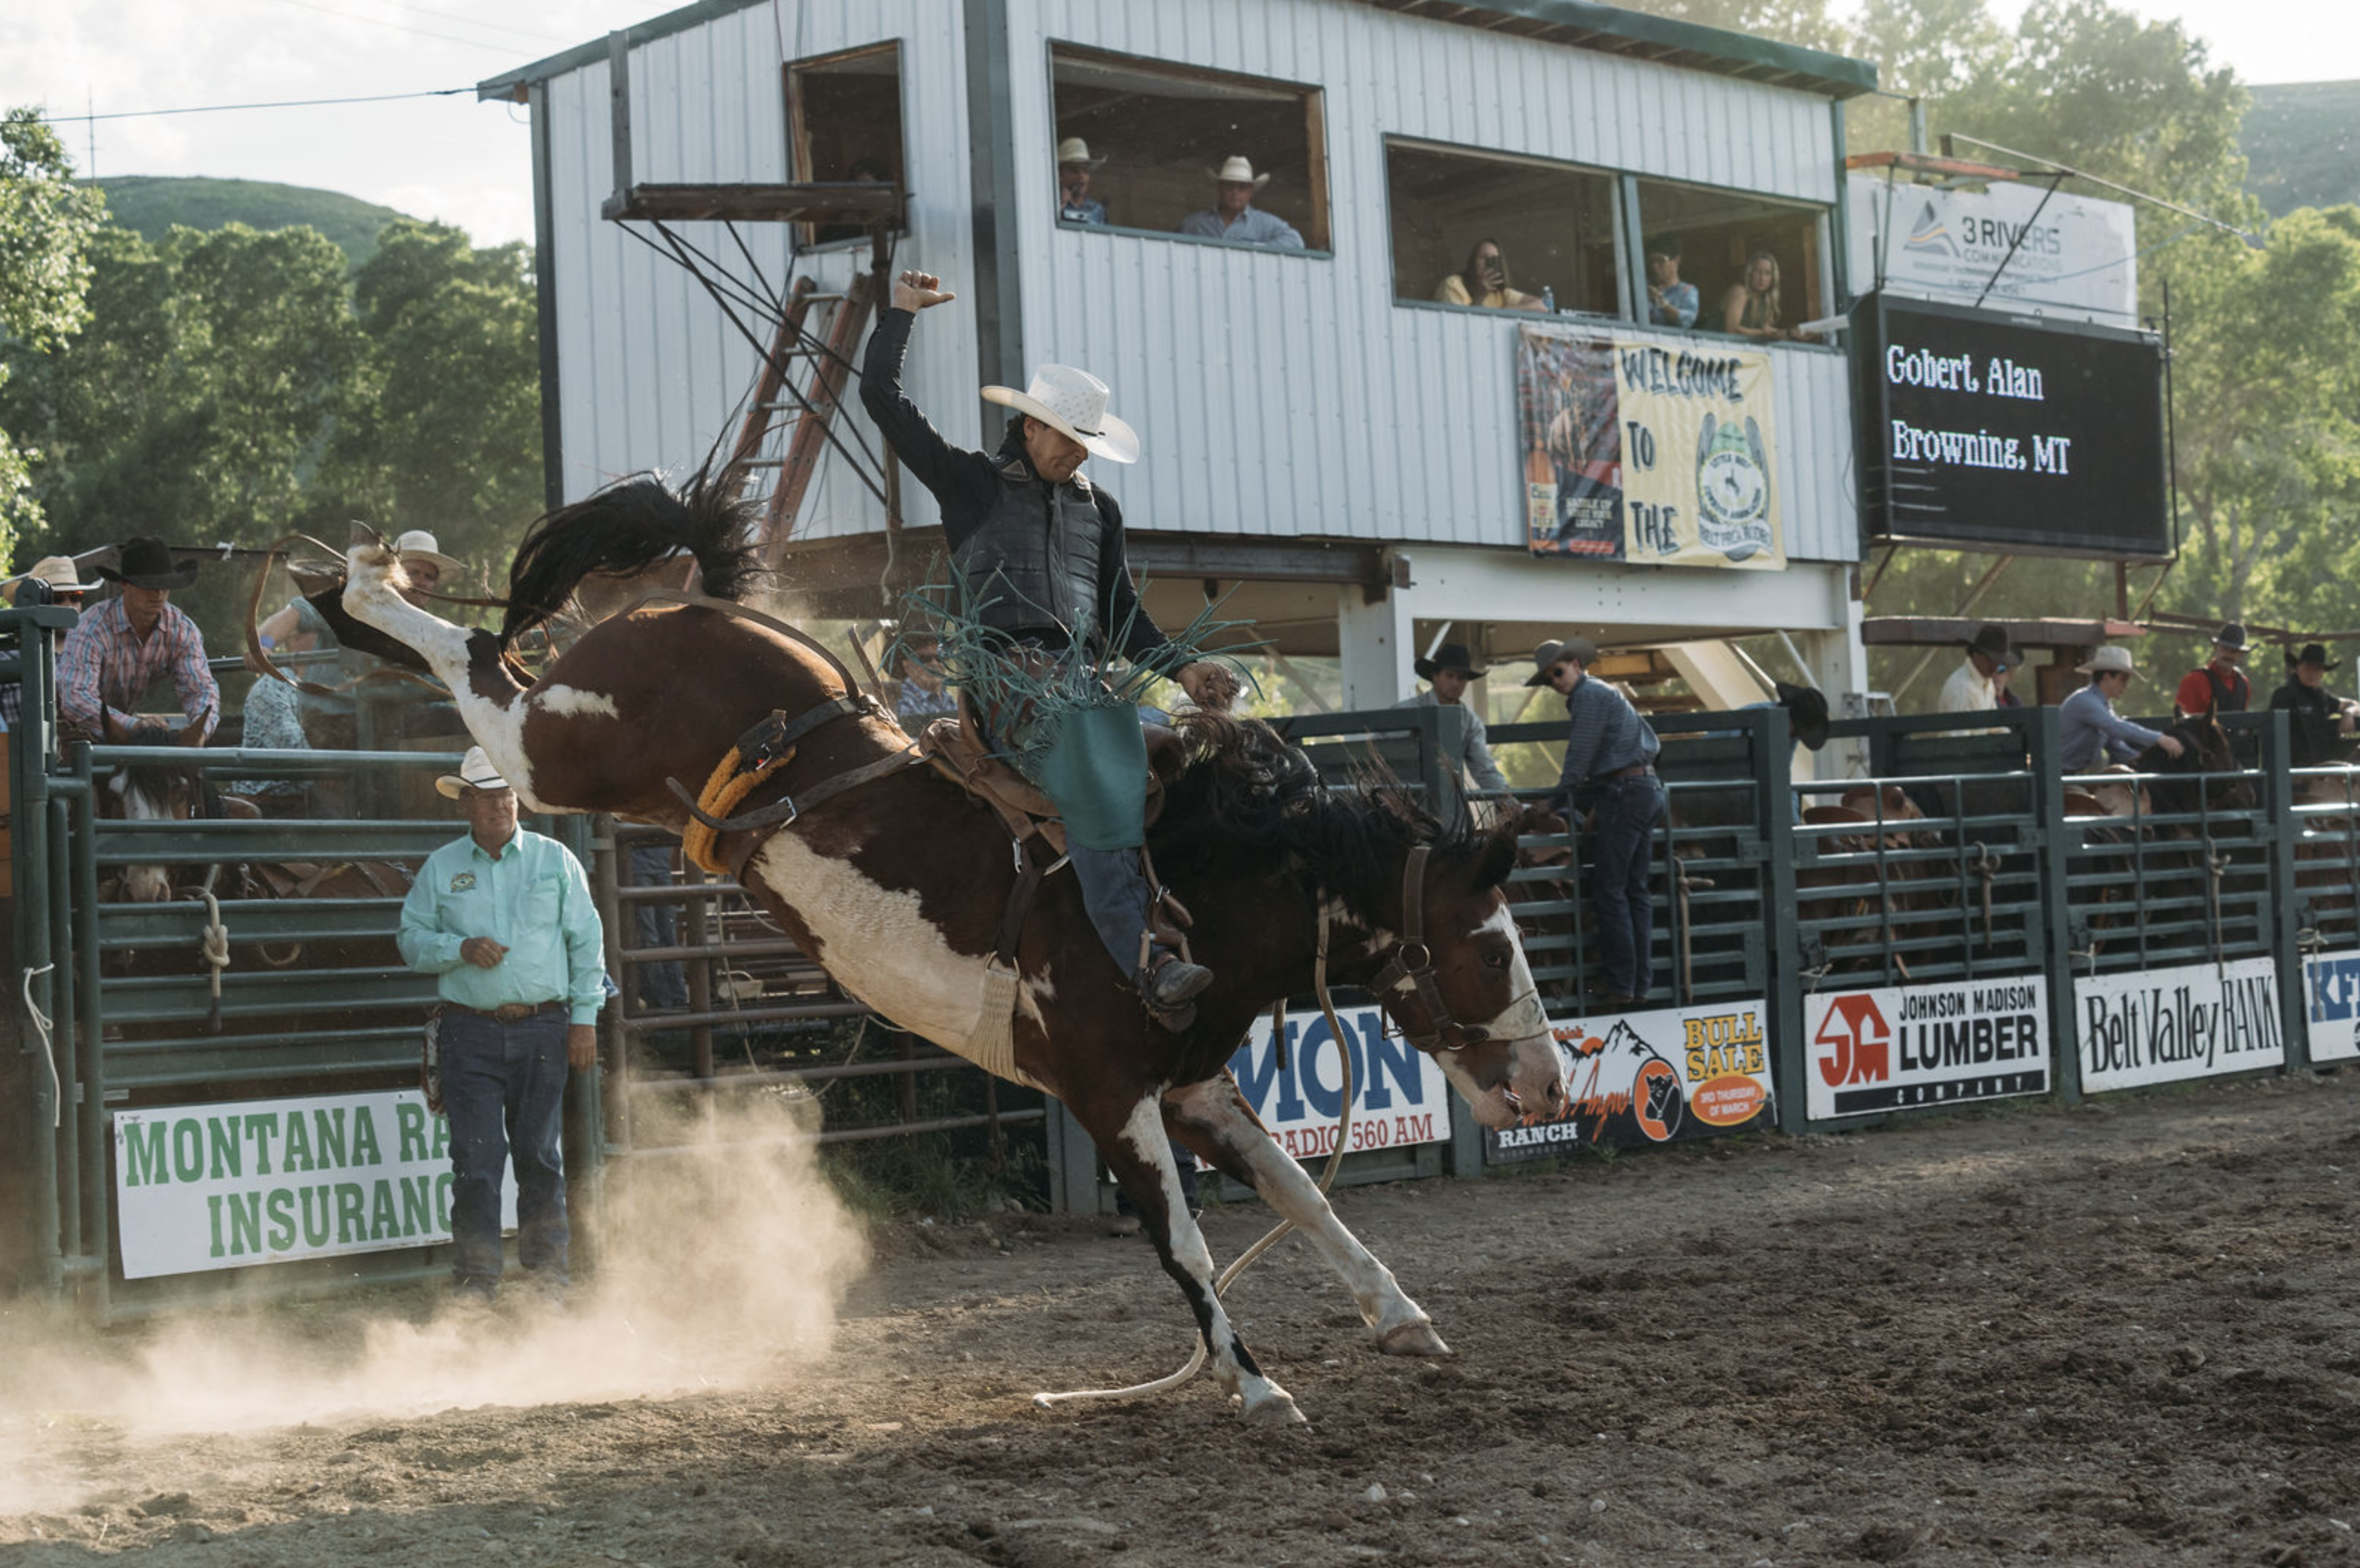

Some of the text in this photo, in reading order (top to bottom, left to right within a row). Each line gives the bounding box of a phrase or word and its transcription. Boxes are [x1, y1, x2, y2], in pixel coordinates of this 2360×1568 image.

[1962, 216, 2061, 255] 3 RIVERS
[1620, 346, 1744, 404] WELCOME
[1886, 344, 2045, 400] Gobert, Alan
[1626, 420, 1656, 473] TO
[1891, 419, 2071, 475] Browning, MT
[1629, 501, 1681, 556] THE
[1899, 984, 2036, 1021] JOHNSON MADISON
[2085, 974, 2280, 1073] Belt Valley BANK
[1683, 1012, 1766, 1082] BULL SALE
[1899, 1014, 2039, 1072] LUMBER
[1699, 1090, 1716, 1104] 3RD
[1721, 1102, 1750, 1115] MARCH
[1897, 1076, 2022, 1105] COMPANY
[123, 1106, 382, 1187] MONTANA
[1350, 1119, 1388, 1151] 560
[1394, 1113, 1435, 1145] AM
[1498, 1122, 1578, 1148] RANCH
